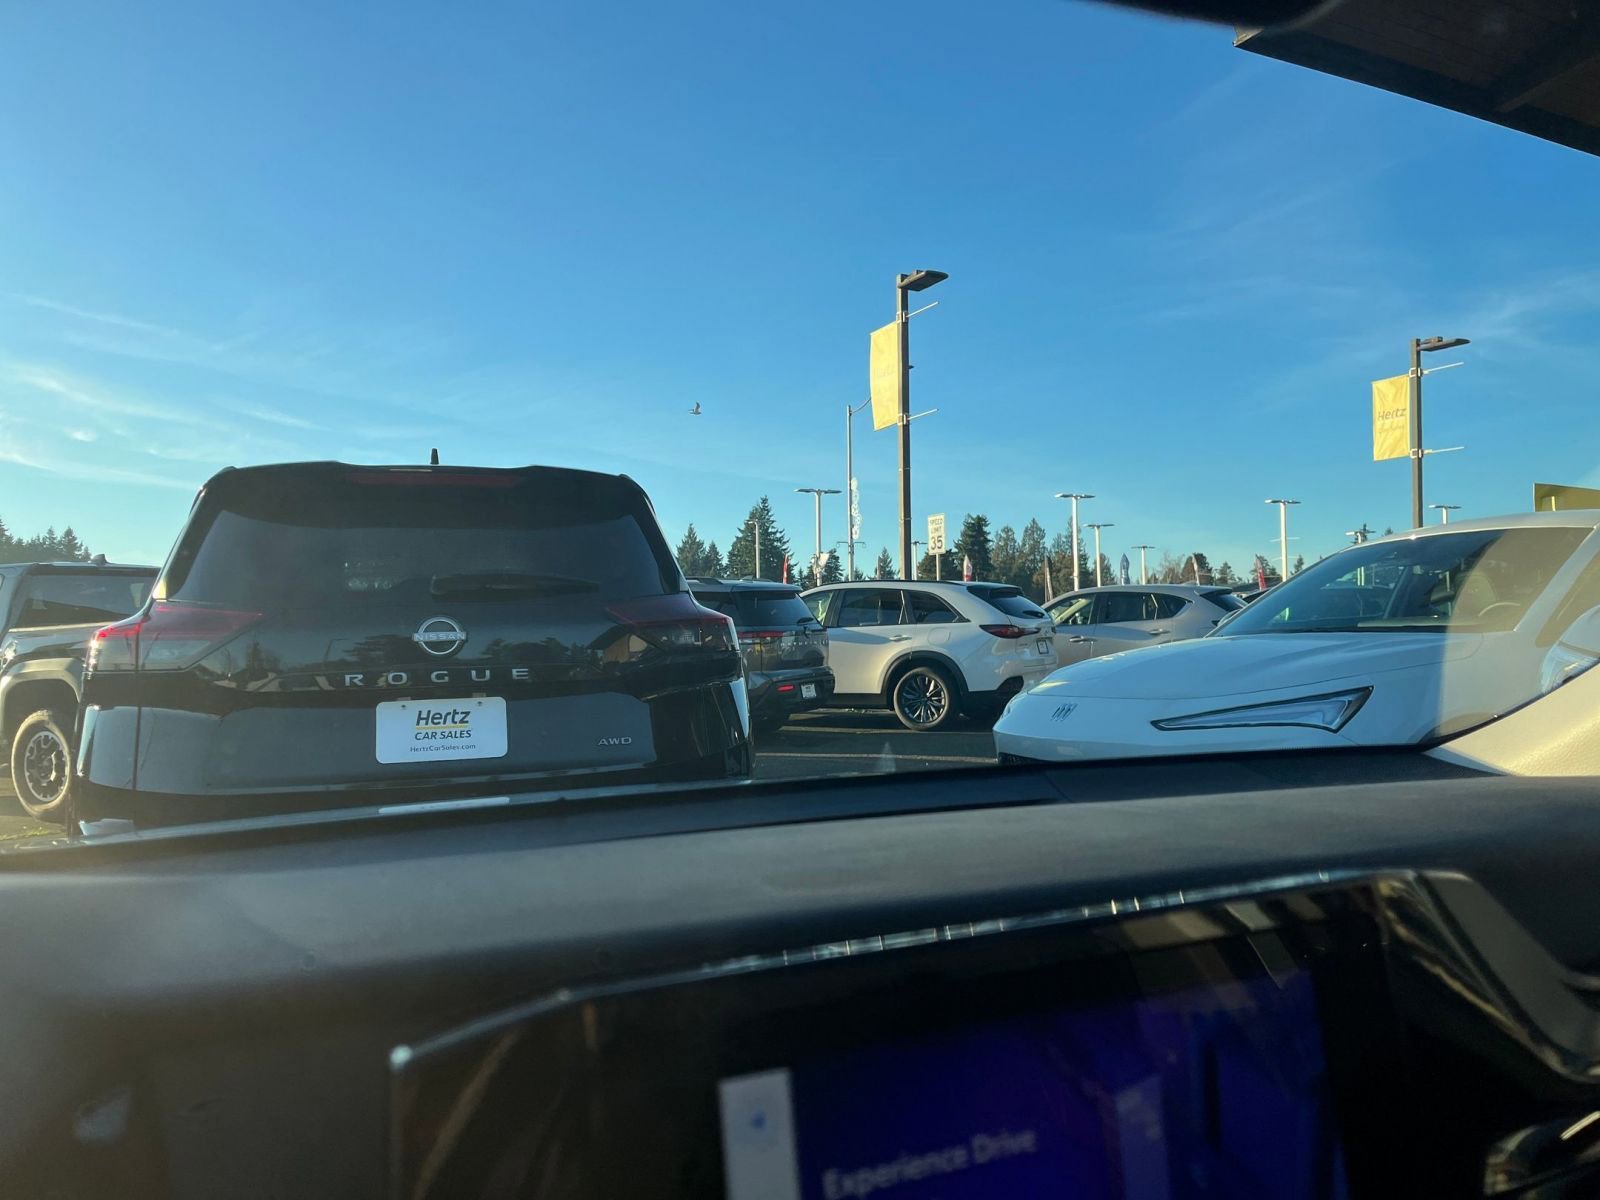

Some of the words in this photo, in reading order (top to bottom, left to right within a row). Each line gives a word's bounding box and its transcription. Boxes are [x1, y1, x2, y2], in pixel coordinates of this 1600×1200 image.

[1377, 407, 1407, 421] Hertz
[930, 535, 943, 550] 35
[415, 632, 465, 641] NISSAN
[344, 668, 529, 687] ROGUE
[416, 709, 471, 726] Hertz
[415, 731, 438, 741] CAR
[440, 729, 472, 740] SALES
[597, 736, 632, 746] AWD
[410, 743, 476, 753] HertzCarSales.com
[822, 1143, 968, 1200] Experience
[971, 1128, 1036, 1165] Drive
